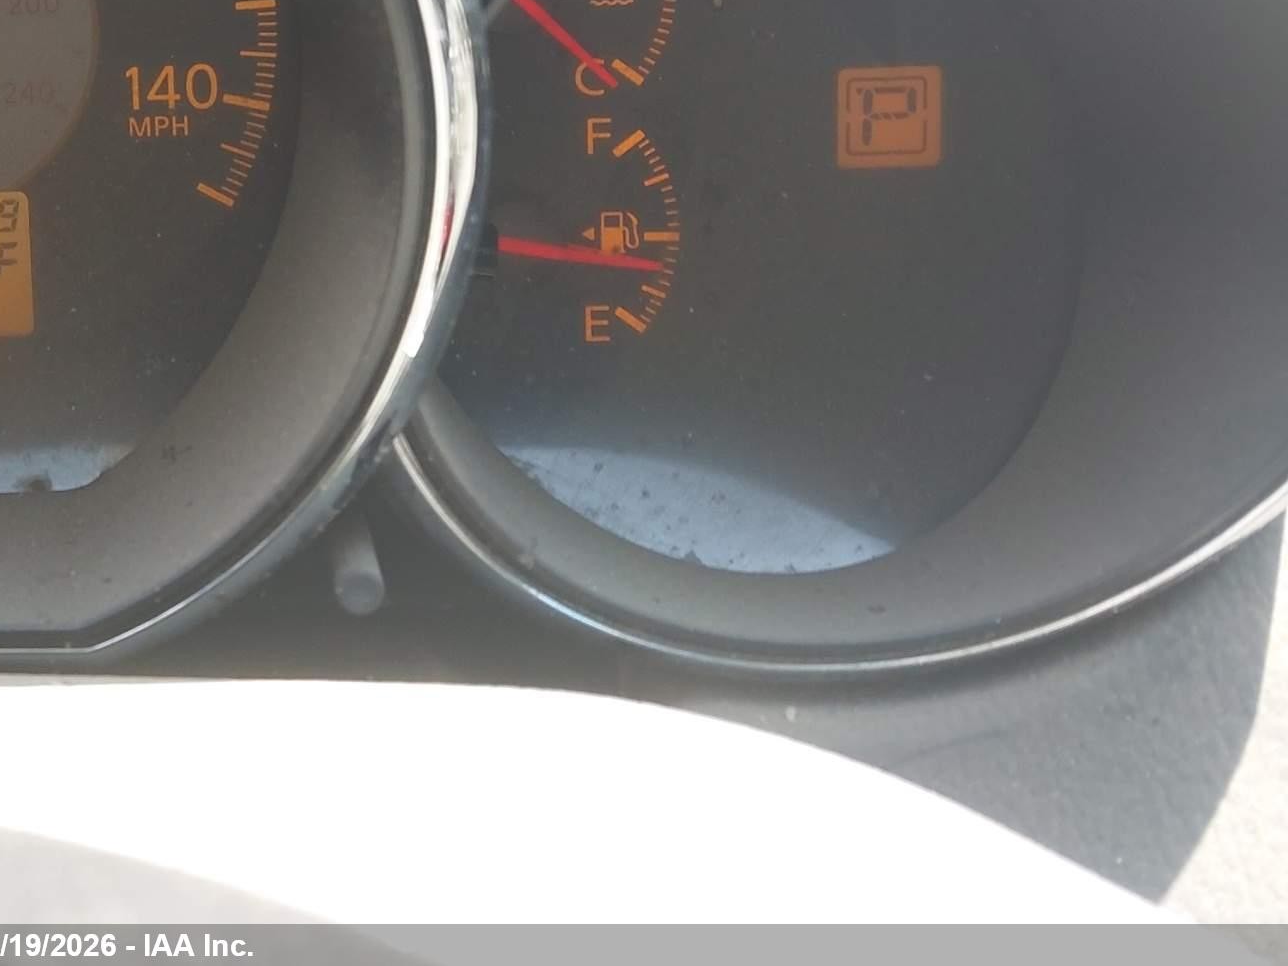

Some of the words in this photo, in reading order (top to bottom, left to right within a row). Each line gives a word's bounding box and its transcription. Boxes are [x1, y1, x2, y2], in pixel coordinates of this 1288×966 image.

[125, 63, 218, 110] 140
[129, 116, 189, 137] MPH
[587, 117, 611, 154] F
[585, 306, 610, 342] E
